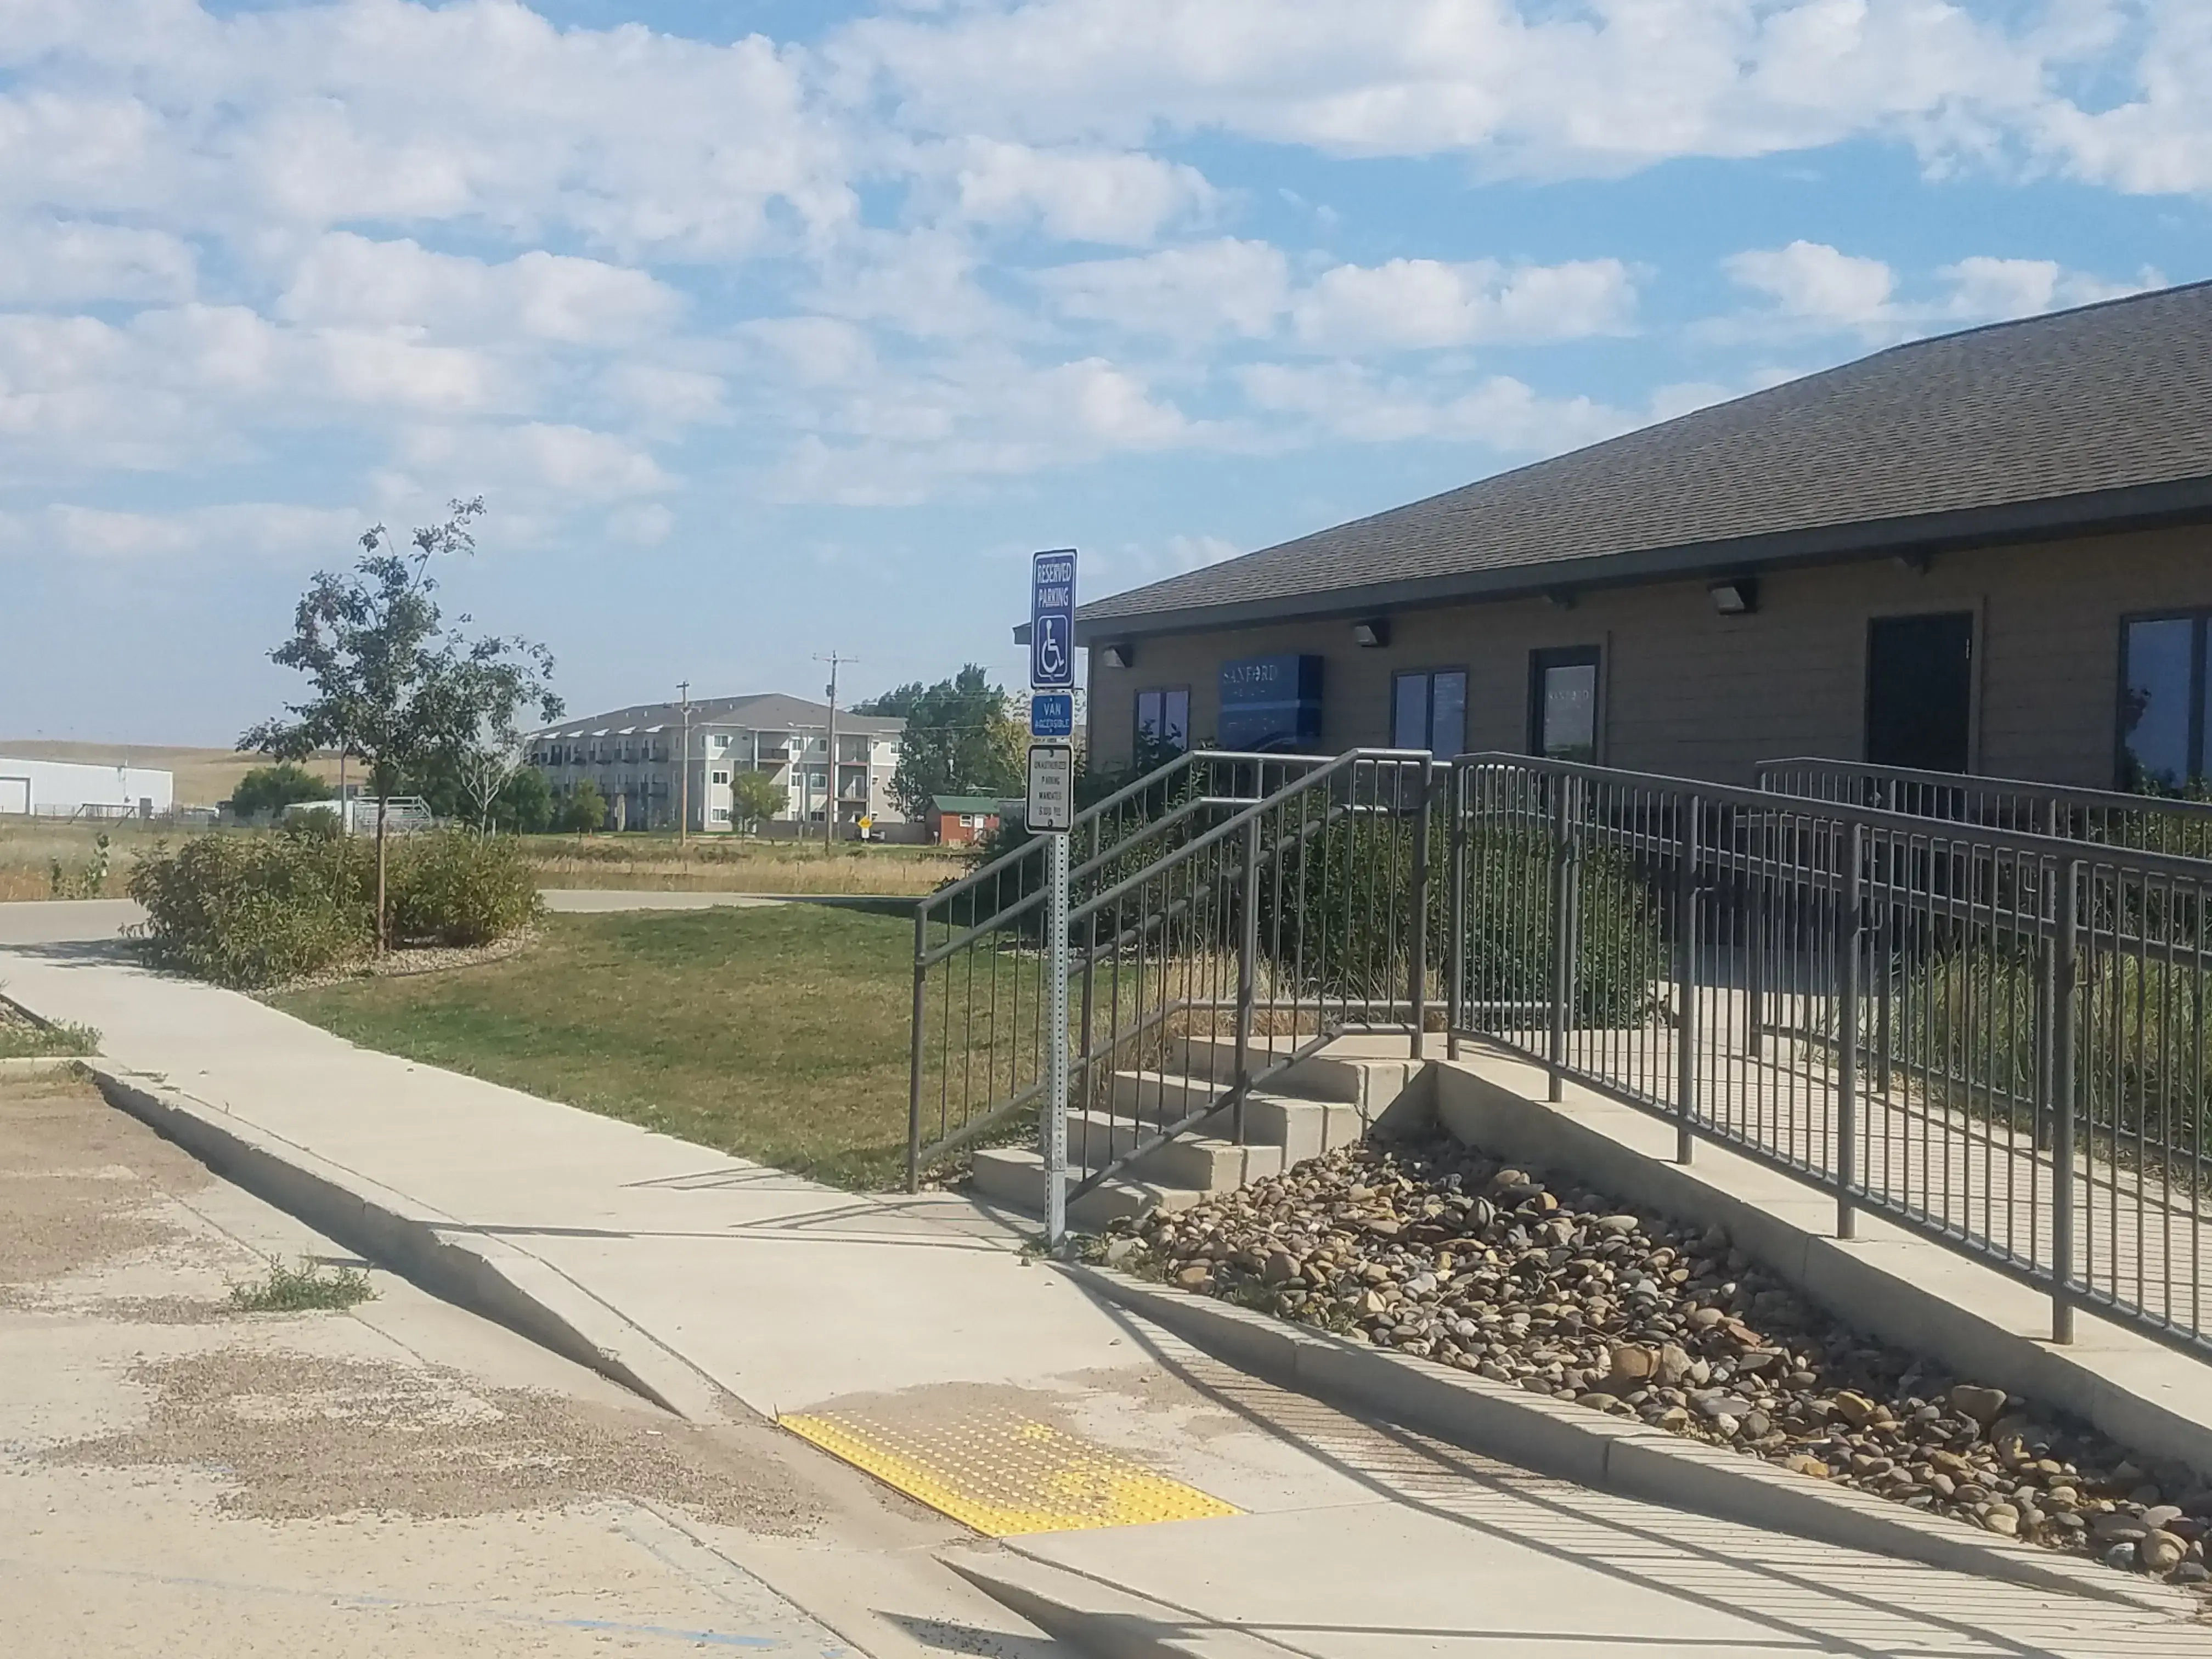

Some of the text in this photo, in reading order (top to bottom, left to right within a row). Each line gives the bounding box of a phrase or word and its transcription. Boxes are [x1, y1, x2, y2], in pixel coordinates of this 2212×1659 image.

[1037, 562, 1071, 583] RESERVED
[1038, 587, 1069, 607] PARKING
[1223, 665, 1278, 684] SANFORD
[1043, 702, 1061, 716] VAN
[1035, 719, 1069, 728] ACCESSIBLE
